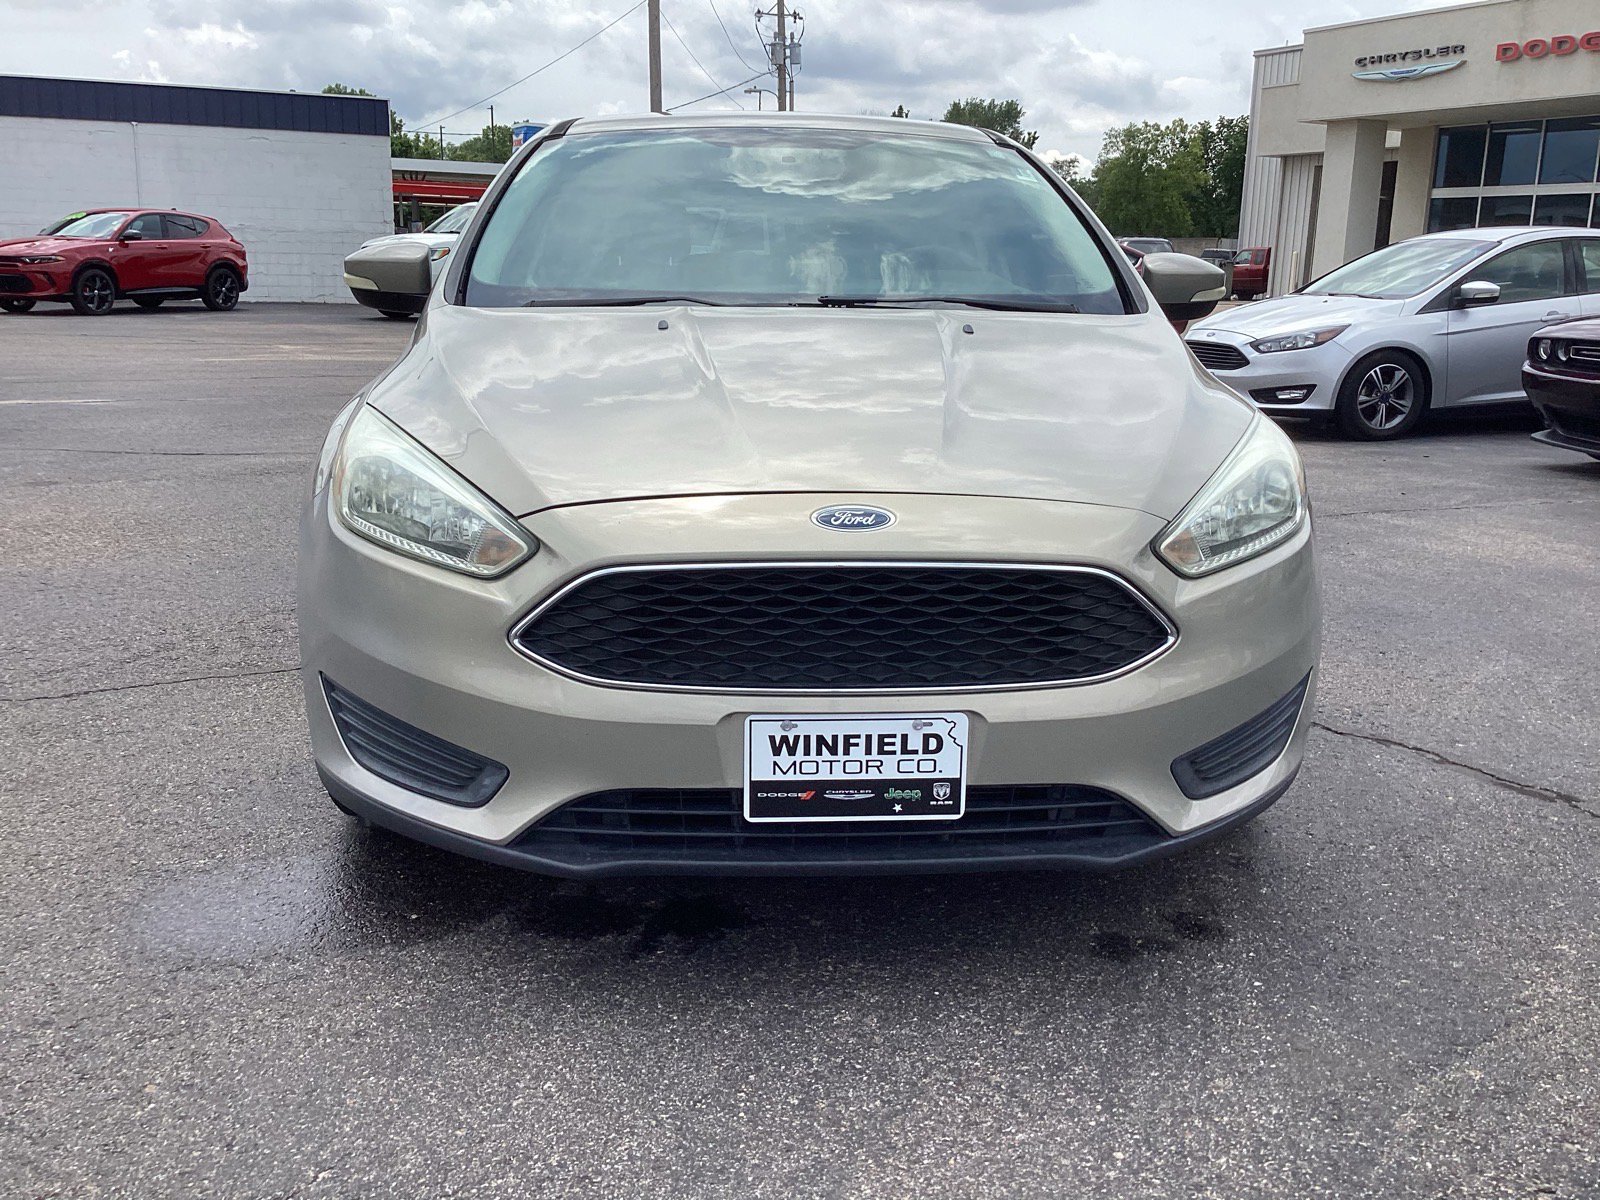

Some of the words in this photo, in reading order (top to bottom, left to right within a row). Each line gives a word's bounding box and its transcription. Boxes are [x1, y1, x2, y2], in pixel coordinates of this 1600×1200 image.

[1355, 44, 1465, 67] CHRYSLER
[830, 510, 876, 525] Ford
[768, 732, 944, 757] WINFIELD
[772, 759, 884, 775] MOTOR
[896, 758, 943, 774] CO.
[884, 788, 921, 801] Jeep
